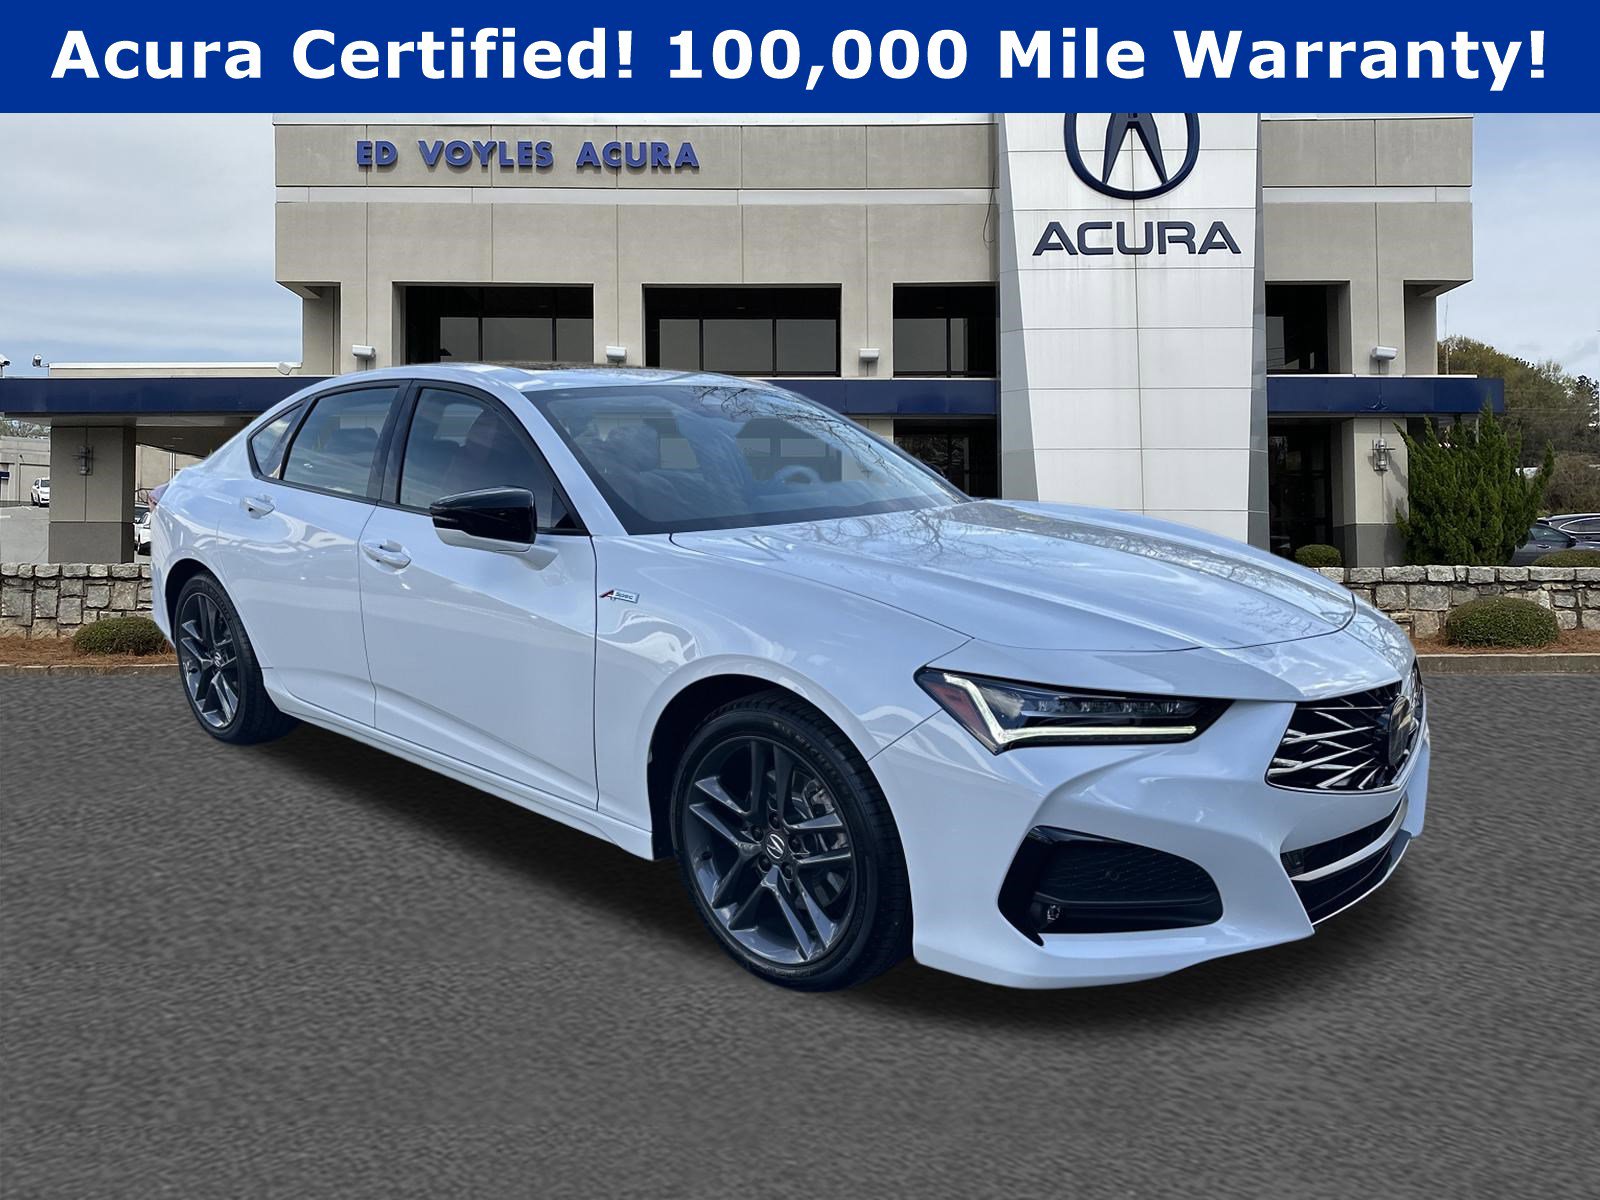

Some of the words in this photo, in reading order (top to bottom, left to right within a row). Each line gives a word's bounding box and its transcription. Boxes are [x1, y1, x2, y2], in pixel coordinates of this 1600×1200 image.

[356, 140, 398, 167] ED
[418, 140, 554, 168] VOYLES
[576, 140, 700, 169] ACURA
[1032, 221, 1242, 256] ACURA
